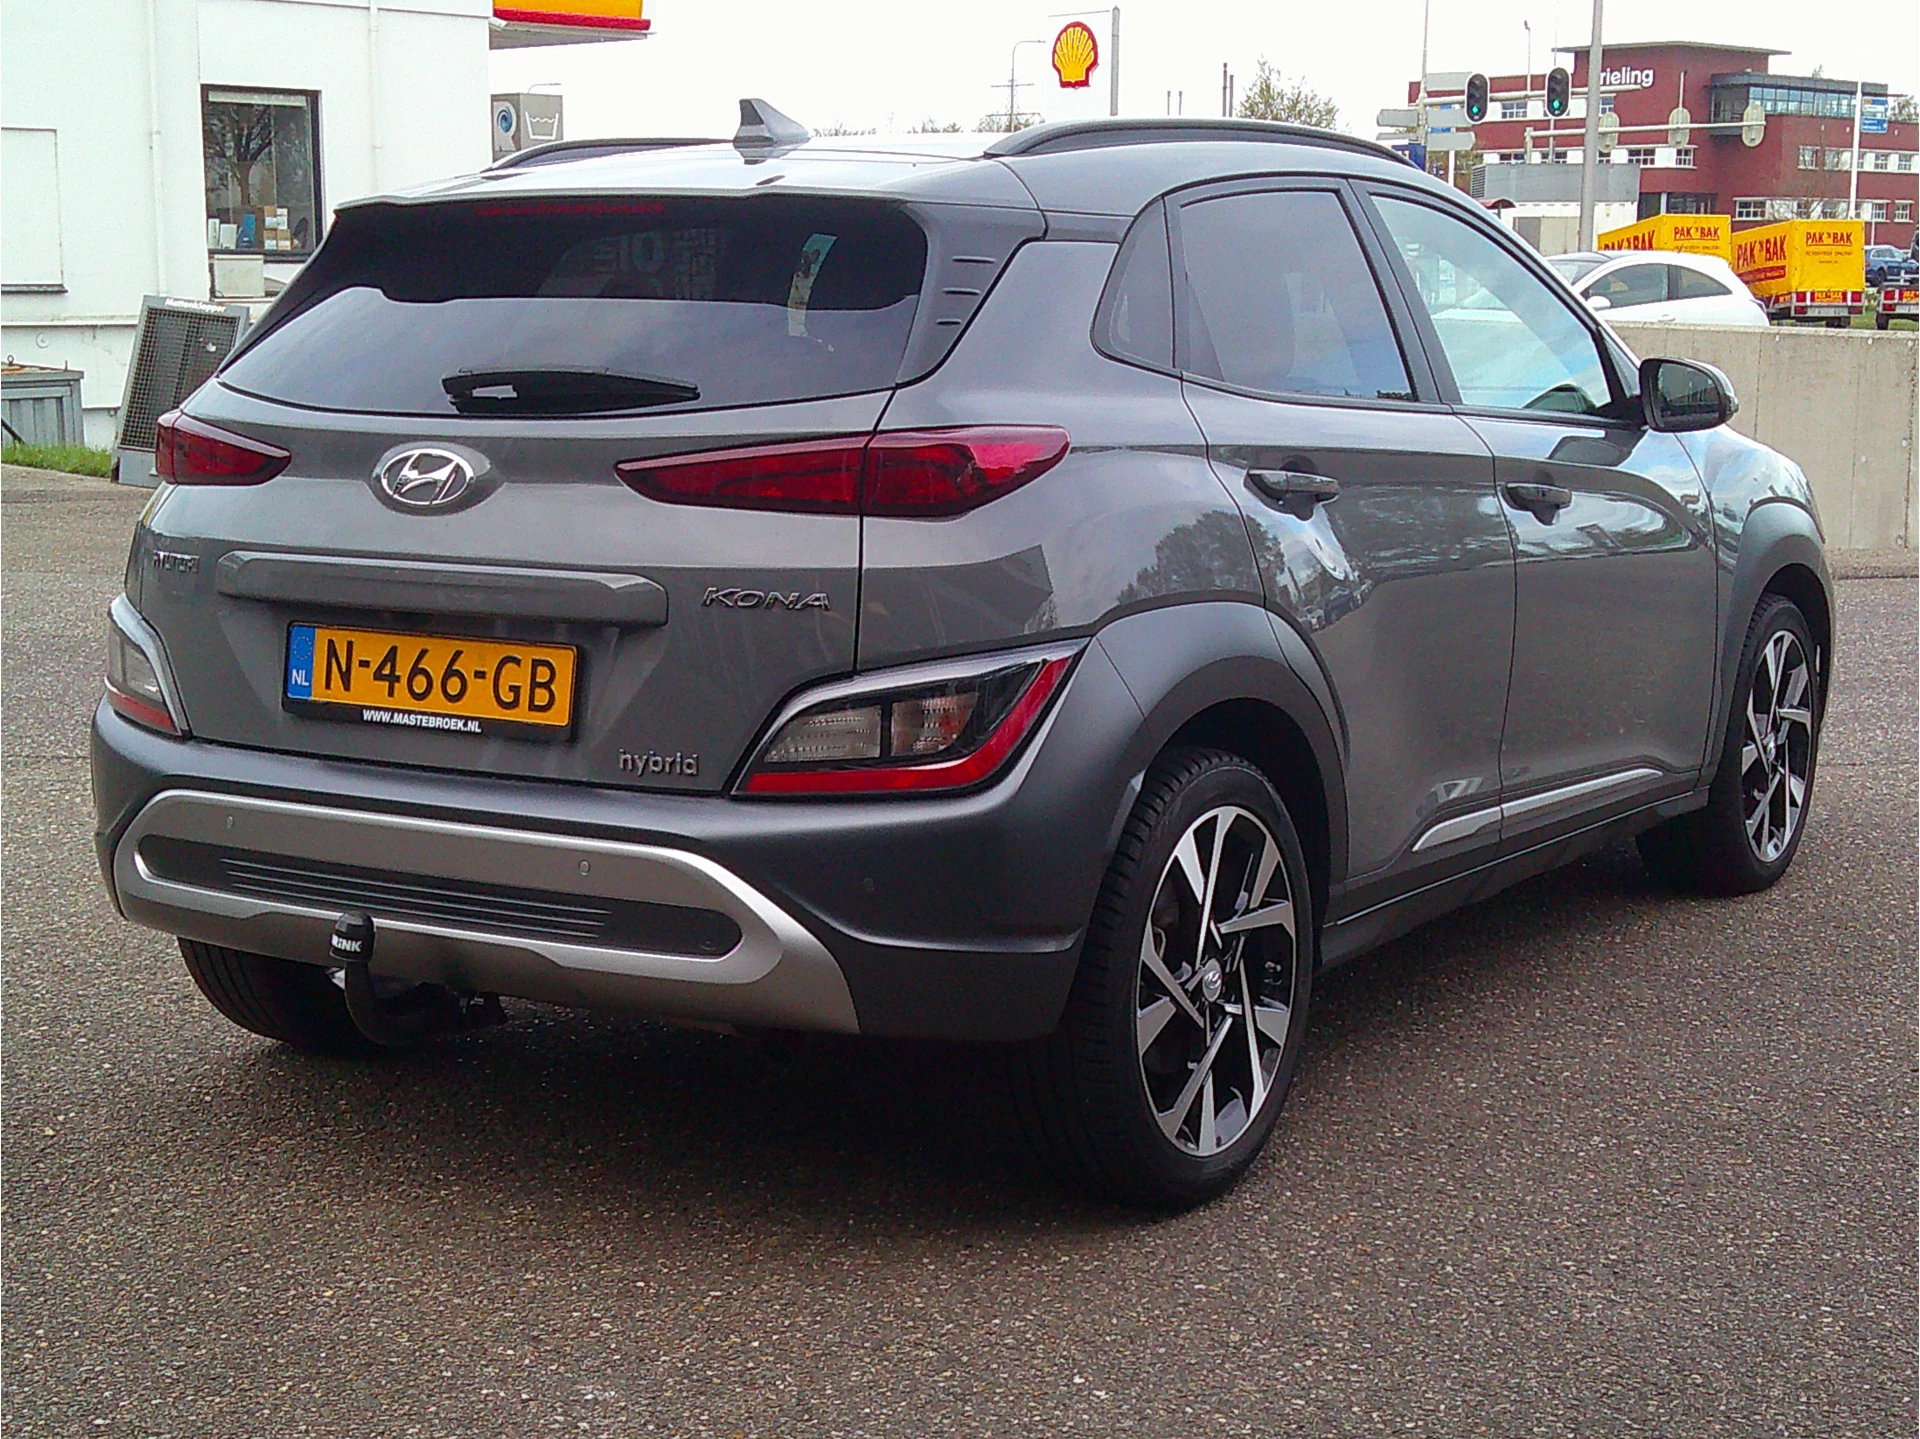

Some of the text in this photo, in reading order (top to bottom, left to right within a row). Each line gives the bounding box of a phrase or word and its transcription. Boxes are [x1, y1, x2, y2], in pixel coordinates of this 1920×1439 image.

[1674, 226, 1692, 240] PAK
[1700, 226, 1720, 240] BAK
[1806, 231, 1825, 244] PAK
[1832, 232, 1853, 244] BAK
[1737, 240, 1757, 270] PAK
[1765, 234, 1787, 262] BAK
[702, 586, 831, 611] KONA
[291, 668, 310, 687] NL
[324, 637, 557, 713] N-466-GB
[362, 708, 482, 734] WWW.MASTEBROEK.NL
[618, 748, 699, 777] hybrid
